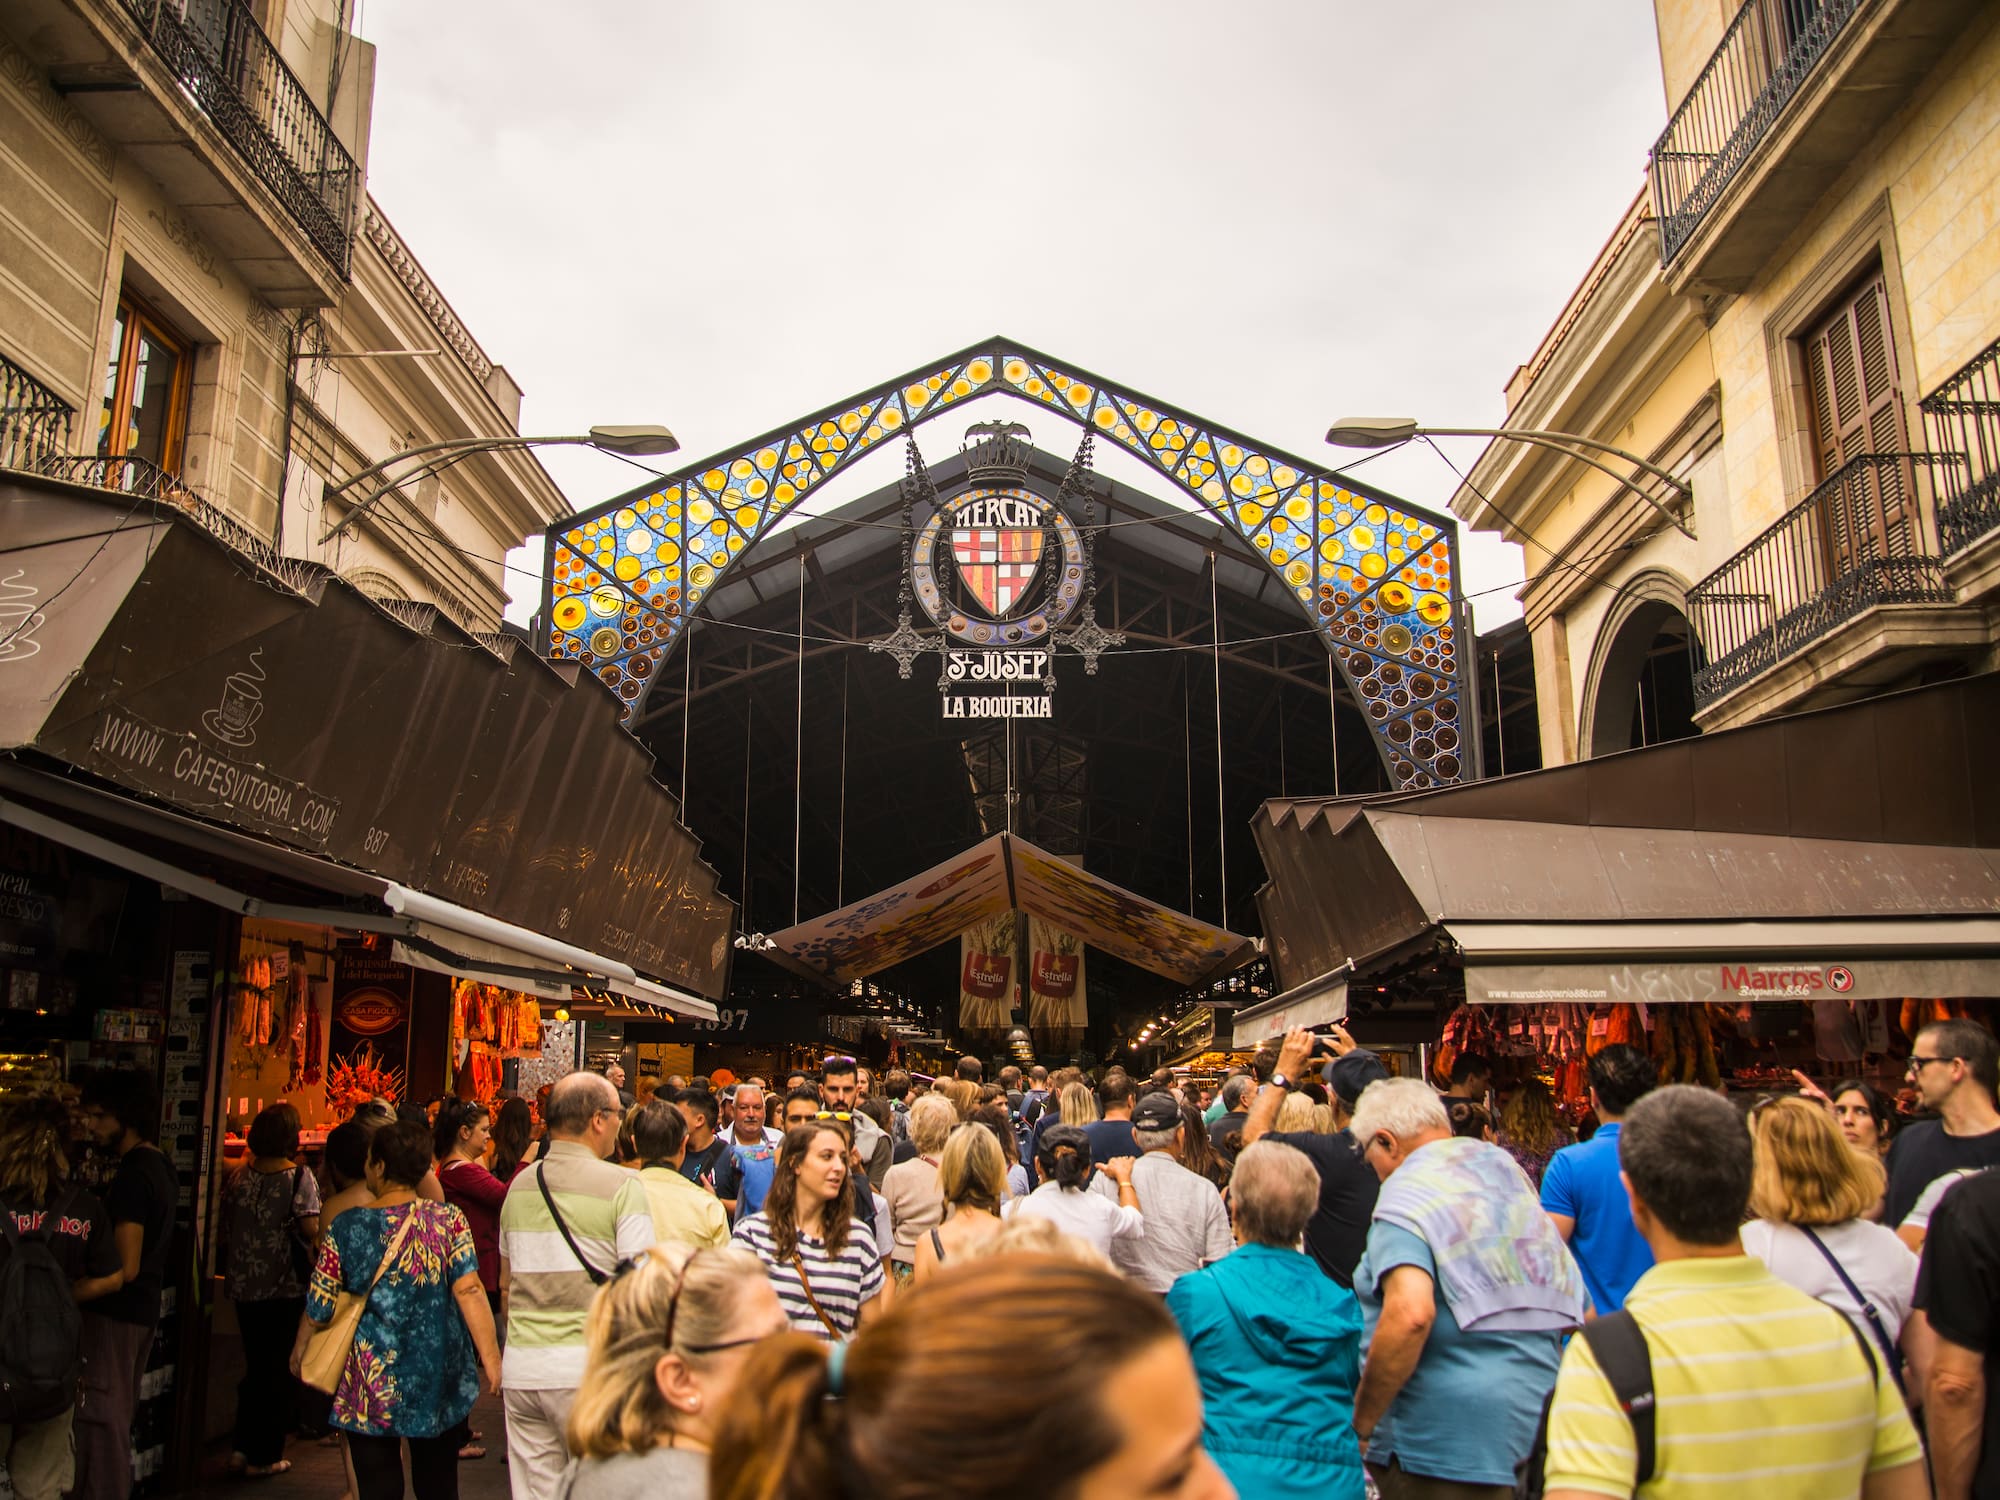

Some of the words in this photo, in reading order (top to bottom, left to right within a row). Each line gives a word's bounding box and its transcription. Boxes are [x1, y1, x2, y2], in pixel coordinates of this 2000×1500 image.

[955, 498, 1041, 527] MERCAT
[971, 651, 1047, 680] JOSEP
[943, 696, 965, 718] LA
[969, 696, 1052, 718] BOQUERIA
[364, 827, 390, 855] 887
[969, 968, 1004, 983] Estrella
[1038, 968, 1073, 983] Estrella
[1721, 965, 1824, 990] Marcos
[344, 1007, 366, 1015] CASA
